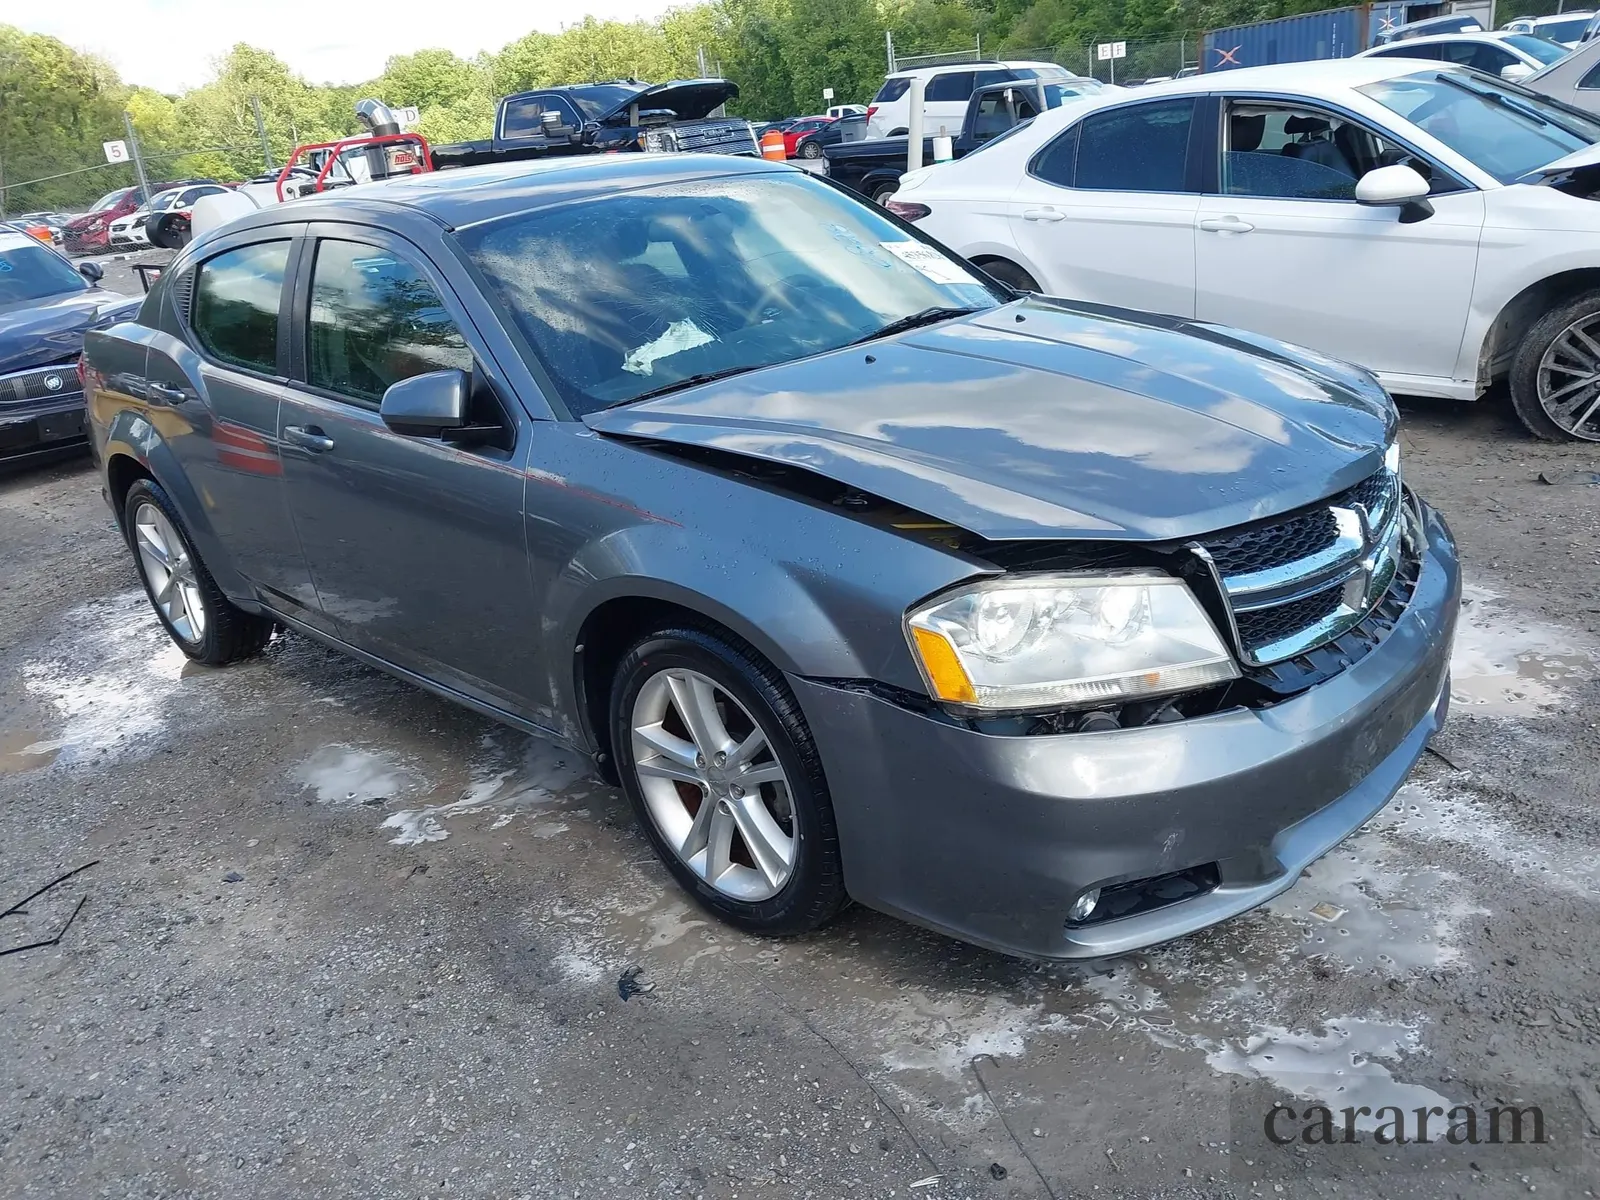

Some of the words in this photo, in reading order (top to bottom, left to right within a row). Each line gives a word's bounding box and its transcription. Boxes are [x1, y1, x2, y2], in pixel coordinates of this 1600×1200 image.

[1101, 46, 1108, 57] E
[1116, 44, 1123, 55] F
[405, 110, 415, 121] D
[111, 145, 121, 158] 5
